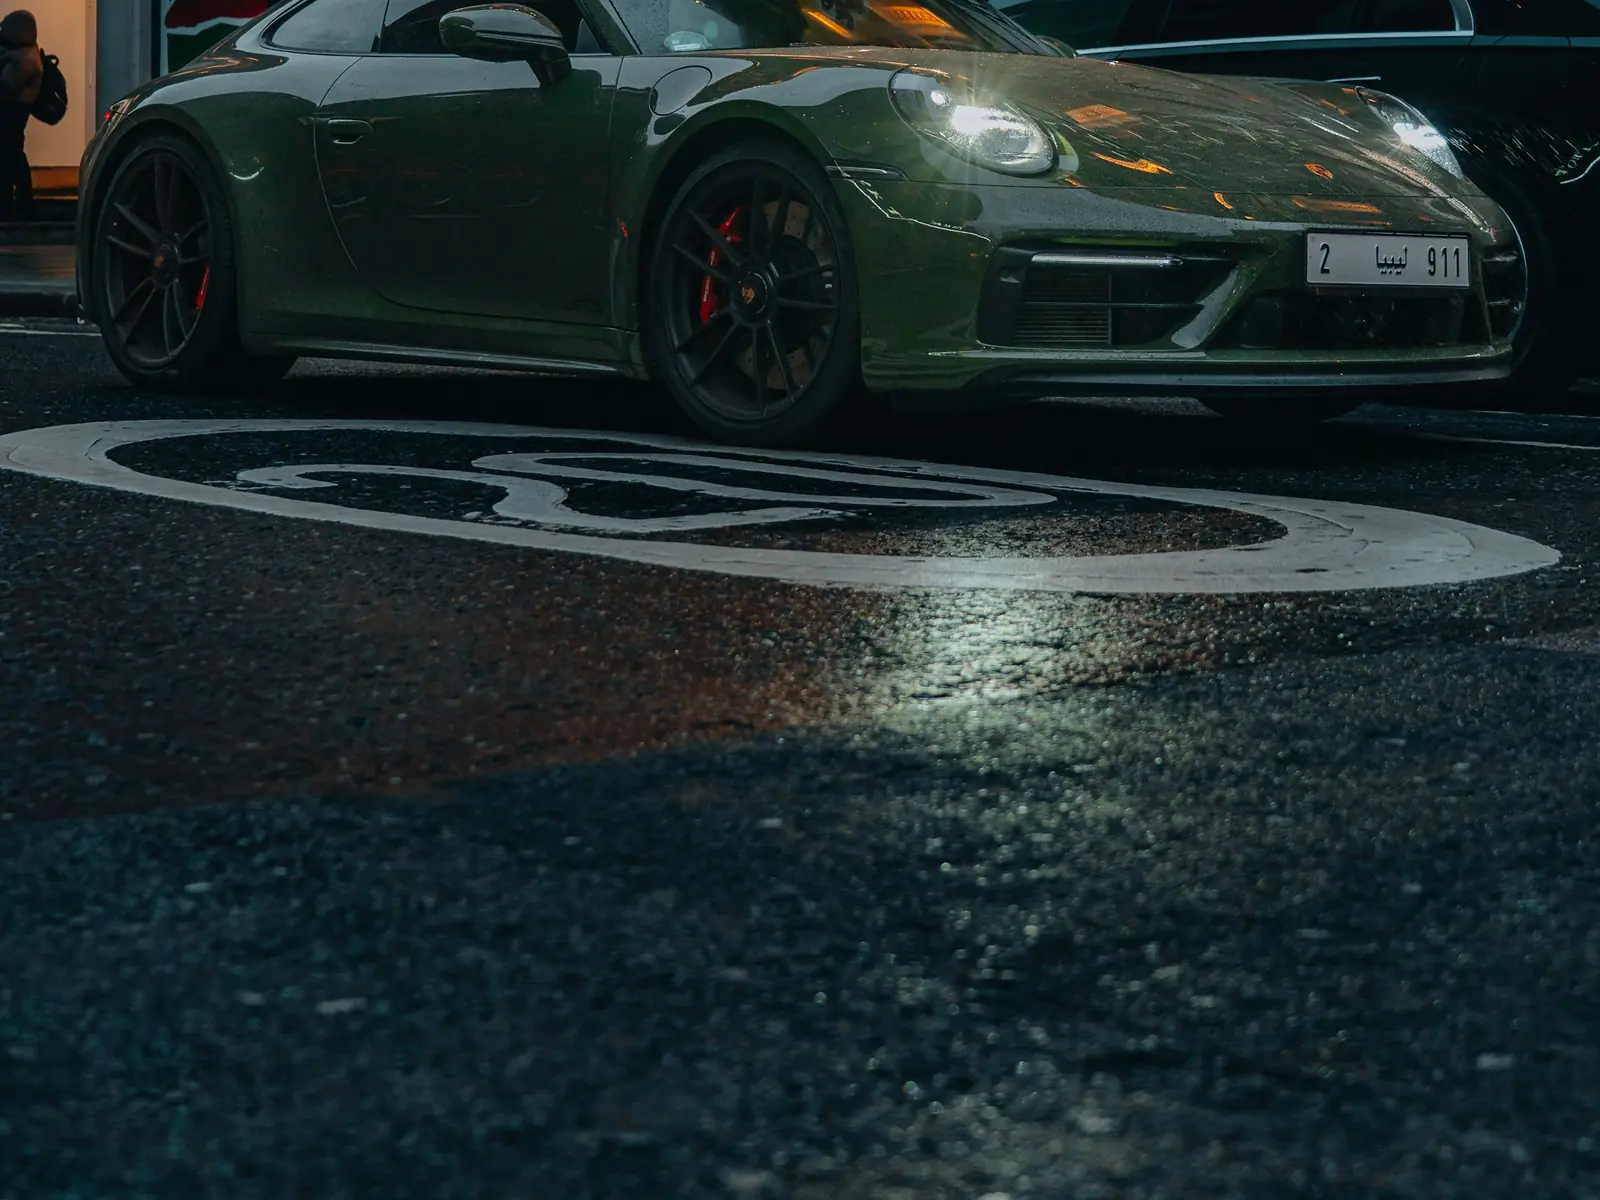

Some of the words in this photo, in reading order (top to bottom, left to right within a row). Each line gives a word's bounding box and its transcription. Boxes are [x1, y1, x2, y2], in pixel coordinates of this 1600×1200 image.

[1319, 242, 1331, 275] 2
[1374, 244, 1408, 275] ليبيا
[1427, 245, 1461, 278] 911
